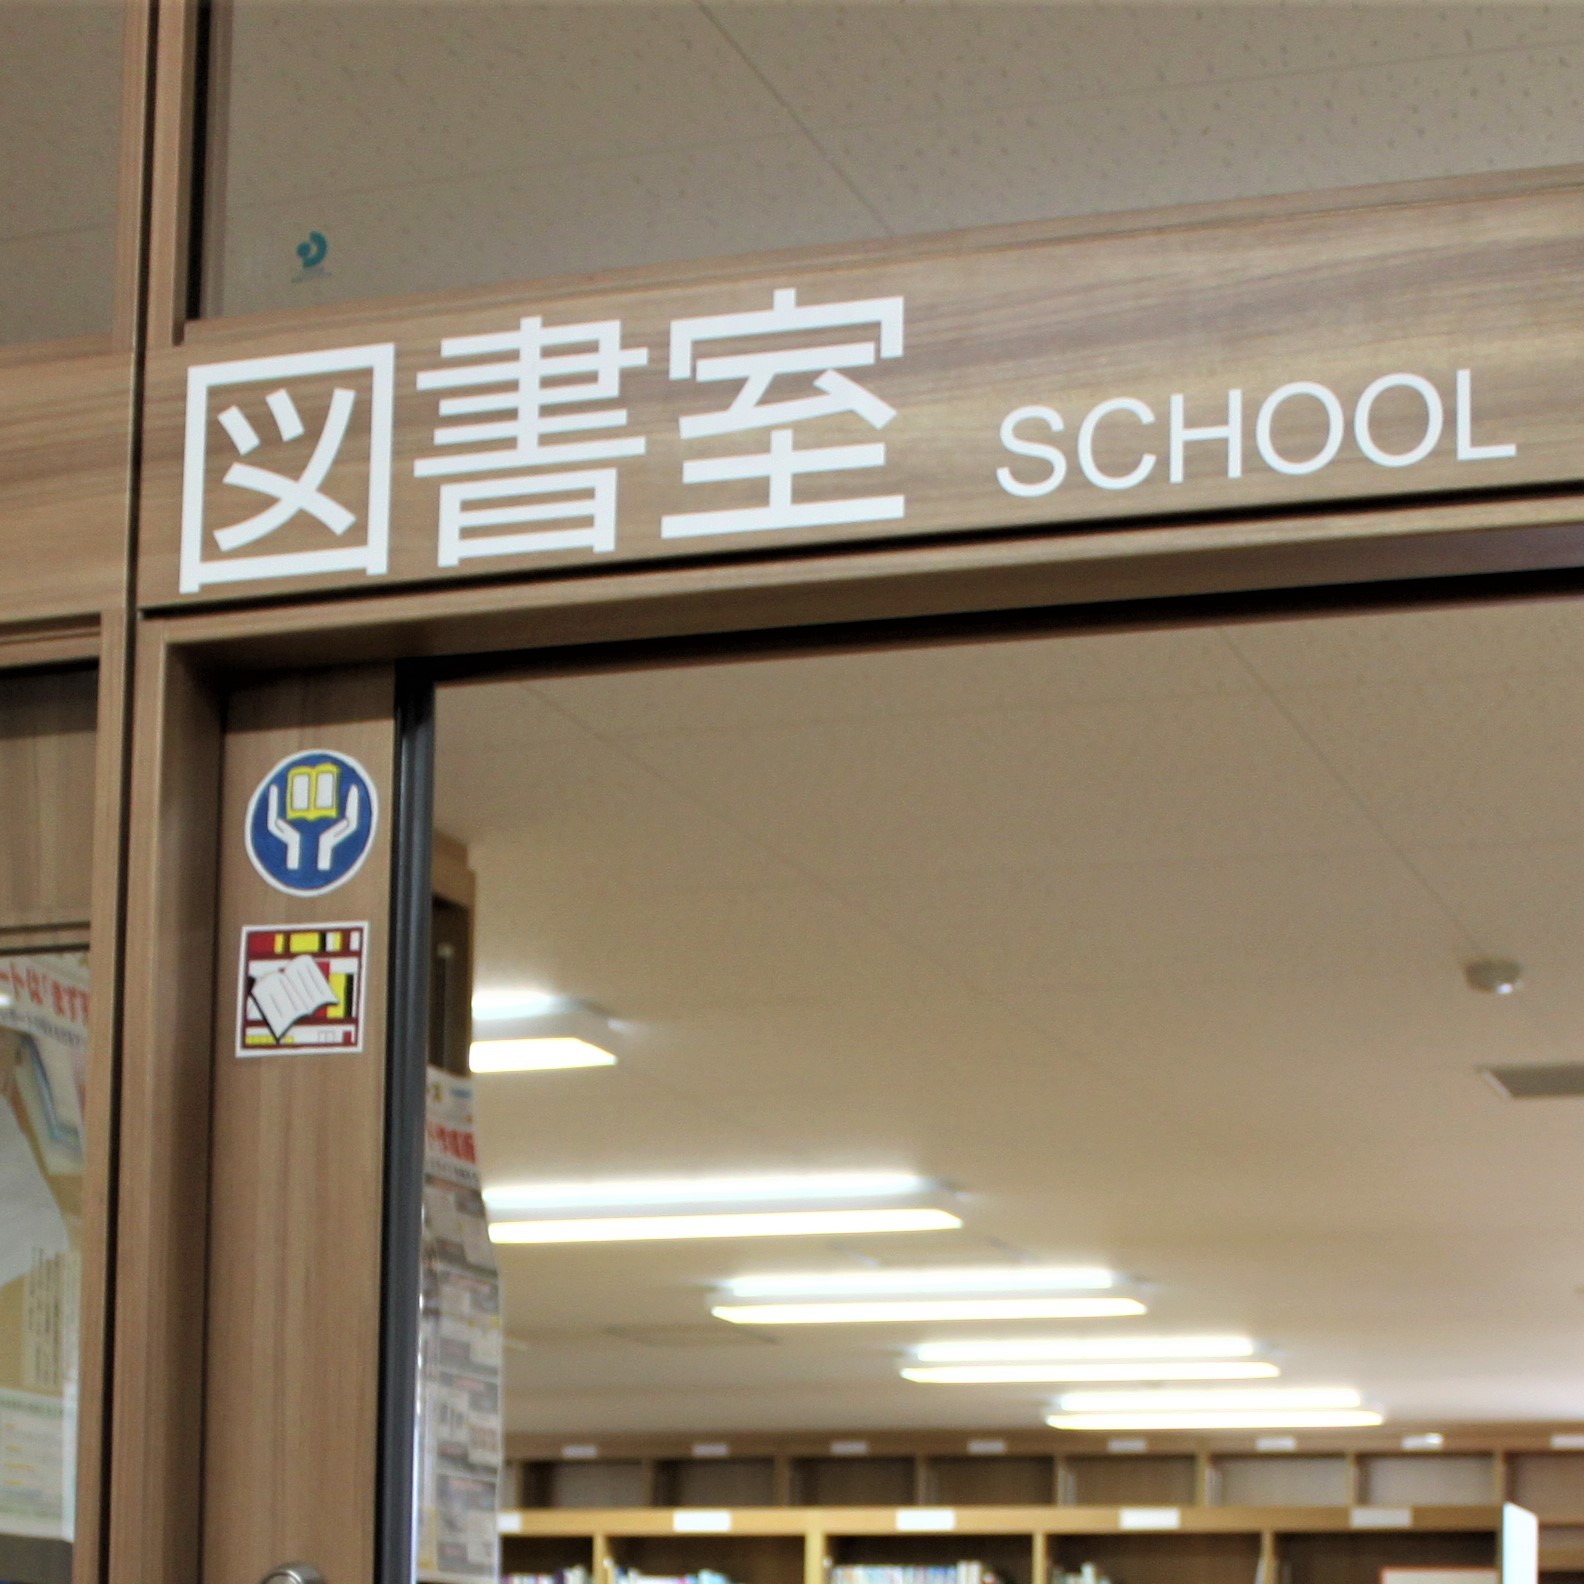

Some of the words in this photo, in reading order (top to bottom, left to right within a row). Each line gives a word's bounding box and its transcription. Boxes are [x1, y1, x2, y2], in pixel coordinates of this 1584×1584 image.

[179, 288, 905, 593] 図書室
[996, 369, 1517, 497] SCHOOL
